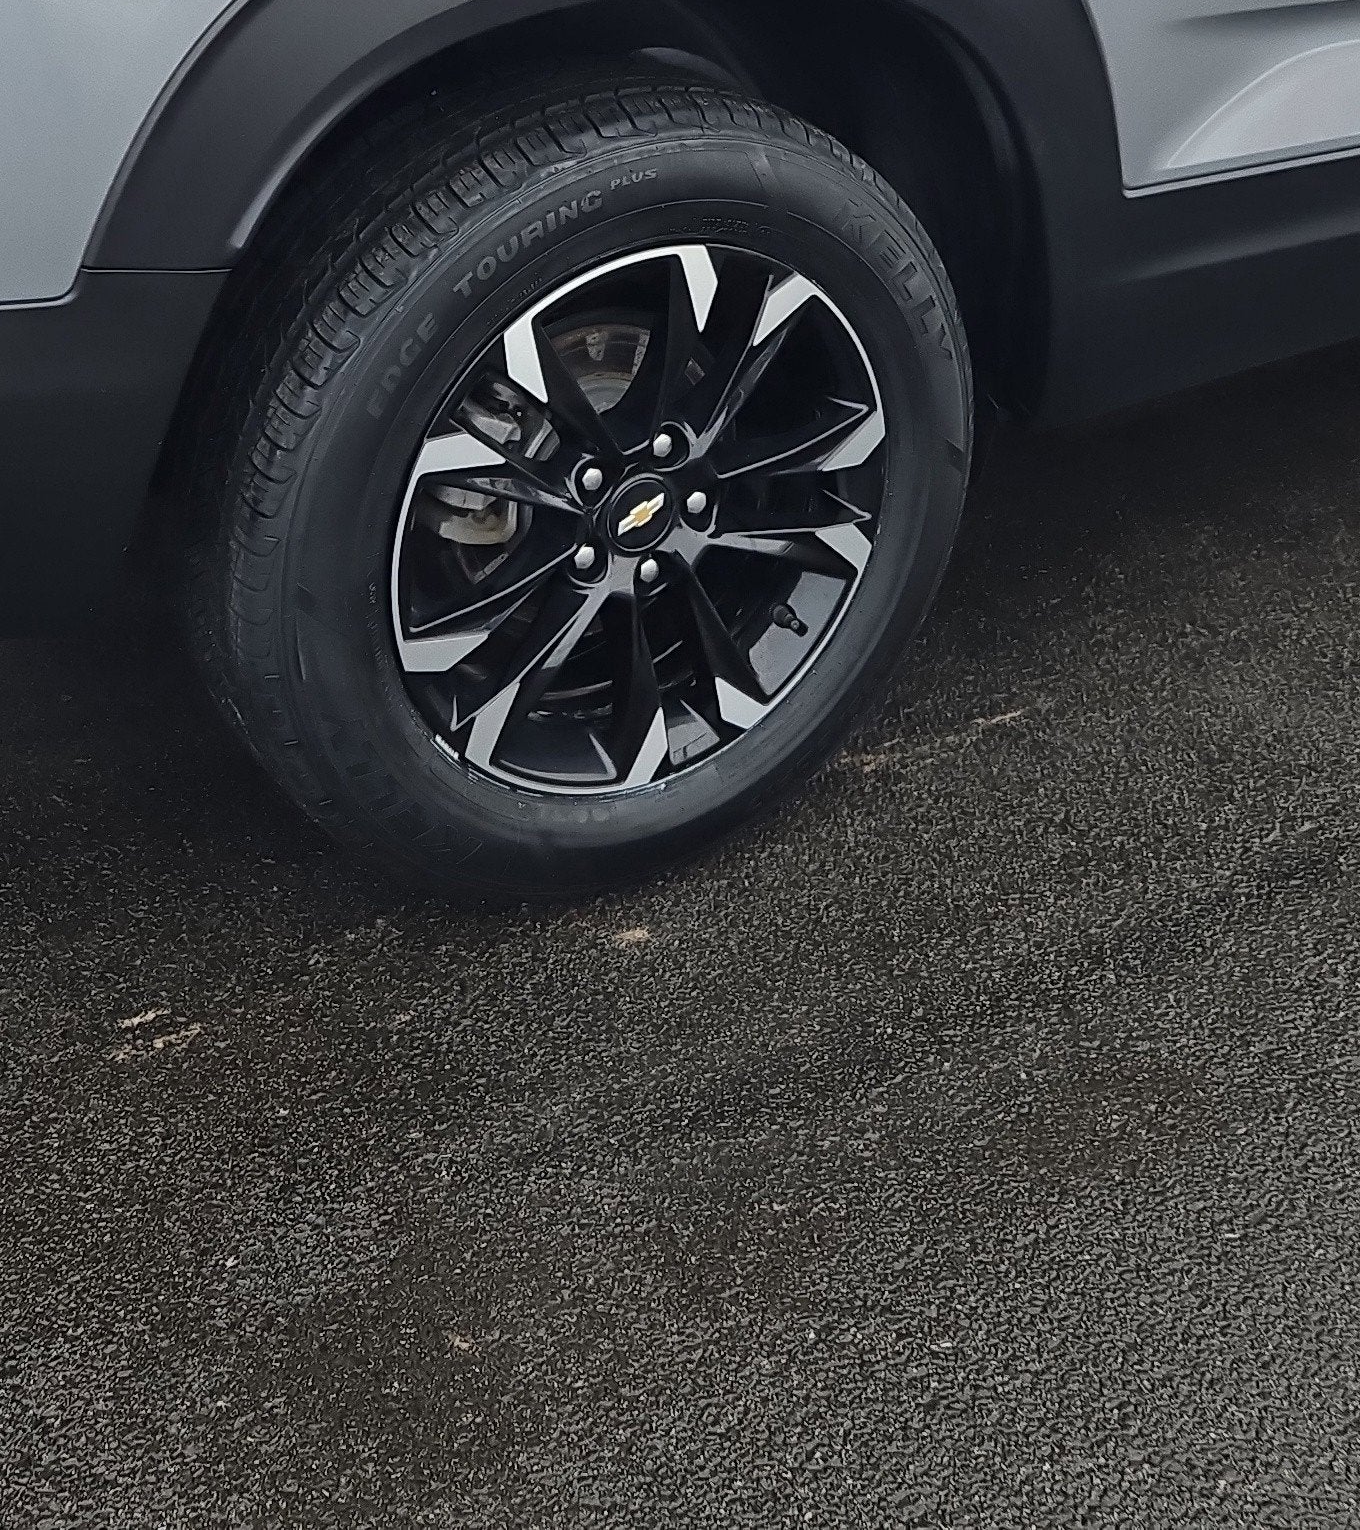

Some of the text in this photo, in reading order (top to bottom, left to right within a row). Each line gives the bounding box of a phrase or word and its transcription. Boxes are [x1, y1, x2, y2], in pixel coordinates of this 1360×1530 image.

[365, 168, 658, 419] EDGE TOURING PLUS
[833, 197, 954, 360] KELLY
